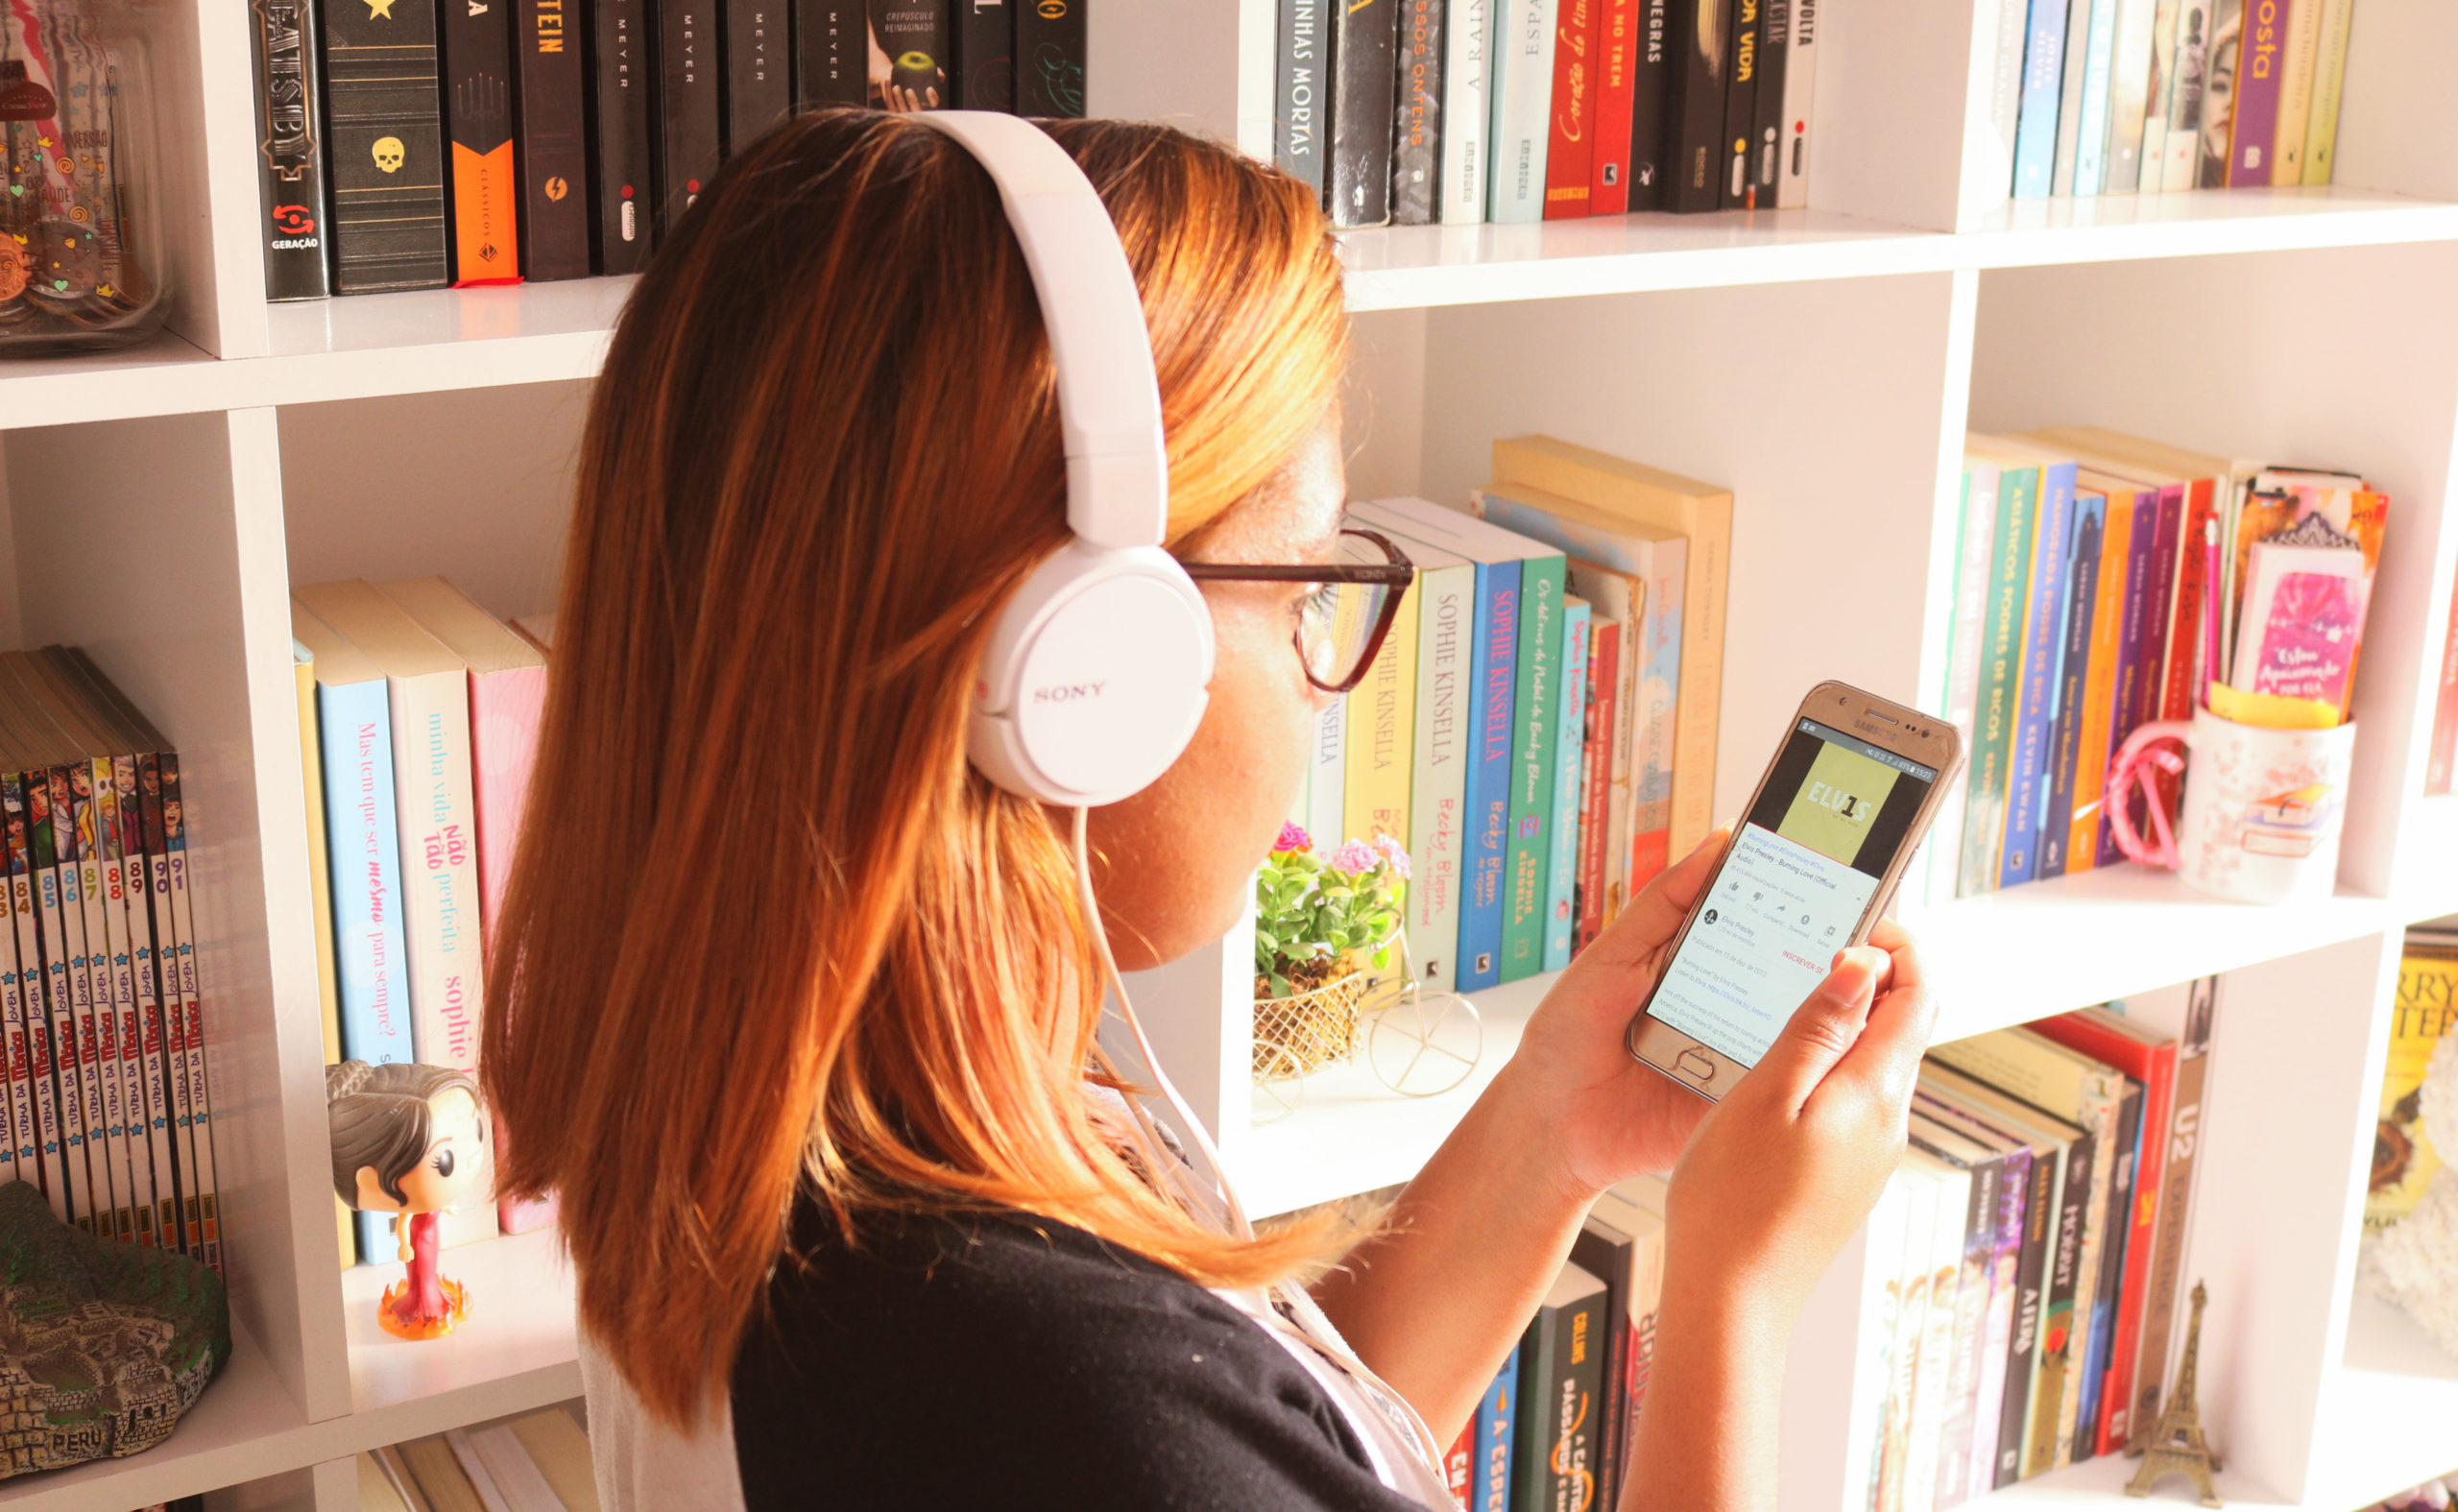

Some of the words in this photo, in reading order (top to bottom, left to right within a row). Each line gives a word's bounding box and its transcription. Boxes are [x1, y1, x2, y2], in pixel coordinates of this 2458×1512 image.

[884, 22, 934, 34] REIMAGINADO
[885, 11, 934, 22] CREPÚSCULO
[1612, 14, 1625, 36] NO
[1648, 0, 1664, 62] NEGRAS
[1766, 0, 1787, 44] KSTAR
[617, 19, 628, 87] MEYER
[684, 14, 693, 84] MEYER
[755, 12, 764, 82] MEYER
[829, 12, 837, 80] MEYER
[1737, 32, 1755, 83] VIDA
[2251, 0, 2277, 79] osta
[1609, 43, 1623, 87] TREM
[1290, 66, 1313, 156] MORTAS
[1410, 63, 1426, 147] ONTENS
[272, 238, 318, 250] GERAÇÃO
[1436, 593, 1458, 668] SOPHIE
[1492, 589, 1514, 660] SOPHIE
[1996, 587, 2012, 655] PODRES
[2037, 590, 2053, 646] PODRE
[1532, 646, 1548, 663] de
[1993, 660, 2006, 683] DE
[2035, 650, 2047, 673] DE
[1034, 684, 1106, 704] SONY
[1530, 665, 1547, 702] Natal
[2030, 676, 2043, 717] RICA
[1320, 689, 1340, 765] NSELLA
[1374, 683, 1396, 771] KINSELLA
[1431, 670, 1454, 768] KINSELLA
[1484, 669, 1509, 763] KINSELLA
[1530, 703, 1543, 720] de
[1987, 686, 2002, 741] RICOS
[359, 722, 376, 757] Mas
[428, 713, 448, 776] minha
[2022, 725, 2036, 776] KEVIN
[361, 760, 374, 789] tem
[359, 796, 376, 826] que
[434, 781, 451, 823] vida
[2016, 780, 2031, 832] KWAN
[365, 831, 377, 855] ser
[1436, 798, 1455, 852] Becky
[1487, 801, 1505, 849] Becky
[423, 832, 444, 870] Tão
[443, 824, 466, 866] Não
[1734, 852, 1756, 867] Audio)
[1740, 840, 1756, 853] Elvis
[1751, 846, 1777, 864] Presley
[1775, 856, 1802, 876] Burning
[1797, 866, 1816, 880] Love
[369, 861, 388, 923] mesmo
[1485, 856, 1503, 906] Bloom
[1514, 851, 1528, 924] KINSELLA
[1525, 857, 1536, 915] SOPHIE
[434, 873, 461, 952] perfeita
[368, 931, 385, 970] para
[372, 971, 397, 1037] sempre?
[2398, 972, 2458, 1006] RRY
[441, 975, 473, 1059] sophie
[2395, 1006, 2453, 1038] TER
[85, 1067, 94, 1082] DA
[106, 1064, 114, 1079] DA
[127, 1063, 136, 1078] DA
[150, 1056, 158, 1071] DA
[175, 1055, 183, 1070] DA
[191, 1052, 199, 1068] DA
[16, 1084, 25, 1099] DA
[39, 1080, 48, 1095] DA
[64, 1072, 74, 1088] DA
[130, 1081, 140, 1117] TURMA
[152, 1074, 161, 1111] TURMA
[176, 1072, 186, 1109] TURMA
[195, 1069, 204, 1106] TURMA
[43, 1098, 54, 1135] TURMA
[66, 1091, 78, 1127] TURMA
[89, 1084, 99, 1121] TURMA
[108, 1082, 118, 1118] TURMA
[18, 1102, 30, 1140] TURMA
[2171, 1103, 2198, 1164] U2
[1571, 1312, 1587, 1364] COLLINS
[53, 1433, 101, 1451] PERU
[1492, 1420, 1507, 1435] A
[1558, 1379, 1576, 1475] PÁSSAROS
[1451, 1452, 1468, 1488] EM
